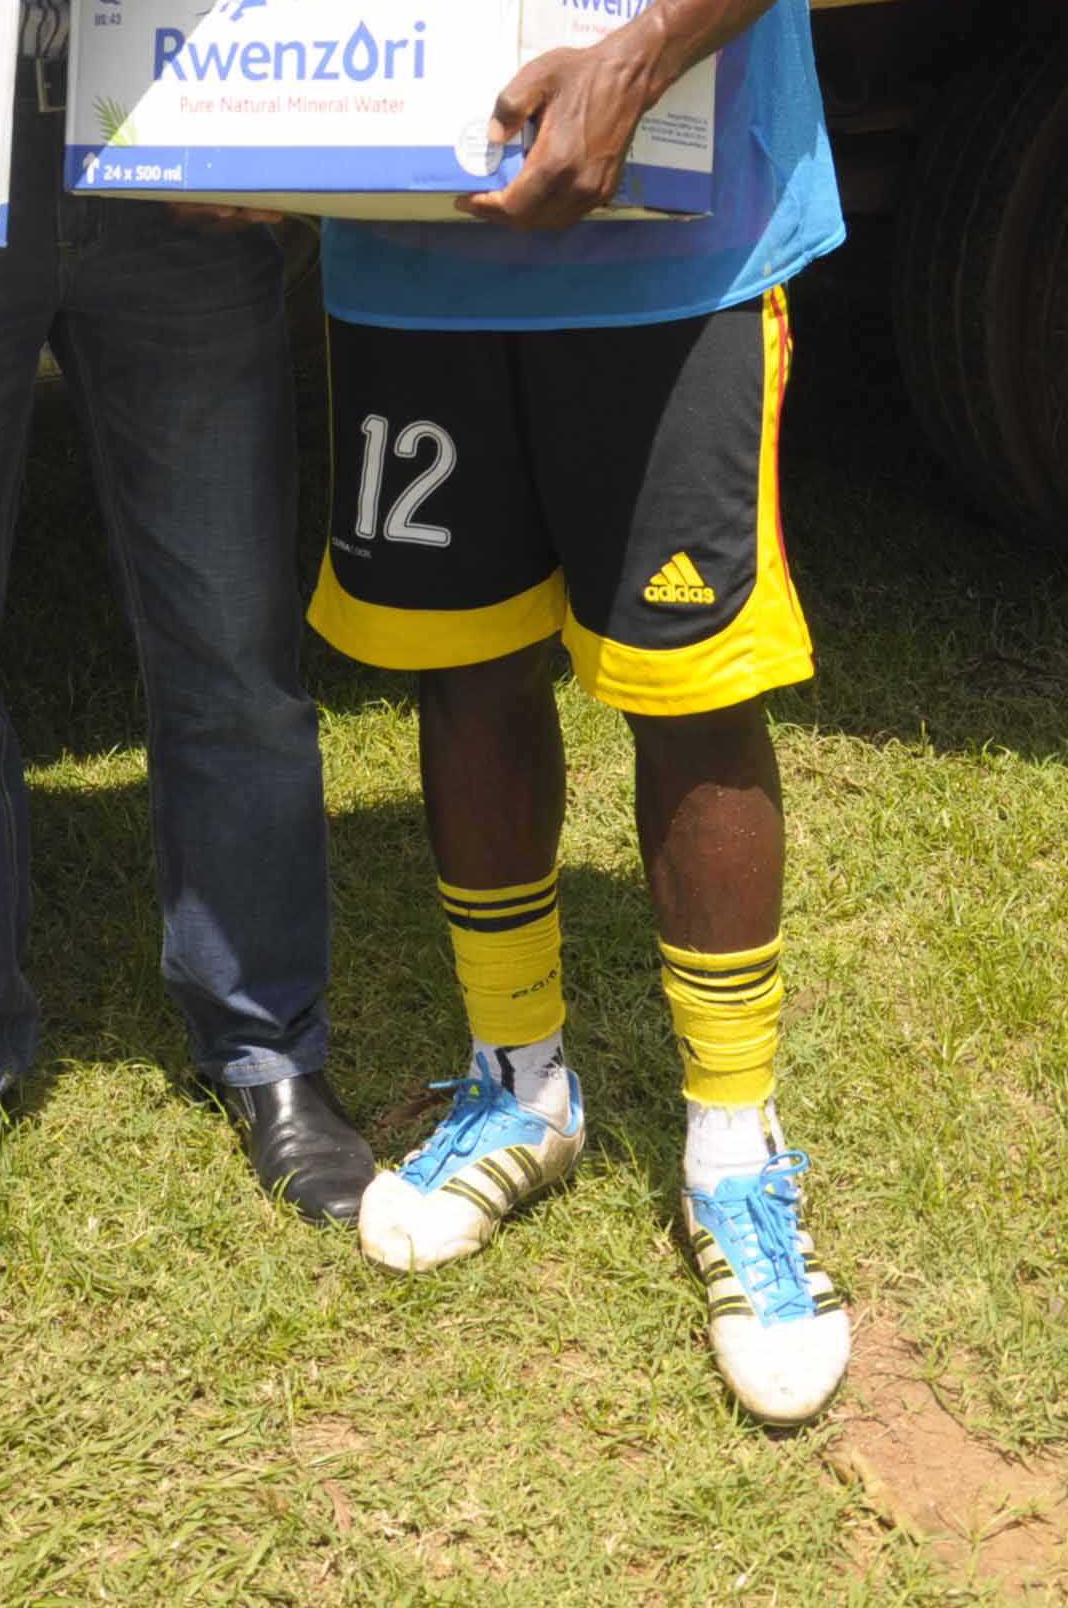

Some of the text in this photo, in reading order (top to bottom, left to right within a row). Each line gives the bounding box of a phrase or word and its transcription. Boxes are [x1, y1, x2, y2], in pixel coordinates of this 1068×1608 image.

[154, 20, 427, 81] Rwenzori
[179, 96, 407, 113] Pure Natural Mineral Water
[103, 165, 120, 180] 24
[135, 165, 160, 181] 500
[163, 164, 182, 181] ml
[356, 413, 457, 548] 12
[643, 584, 716, 604] adidas
